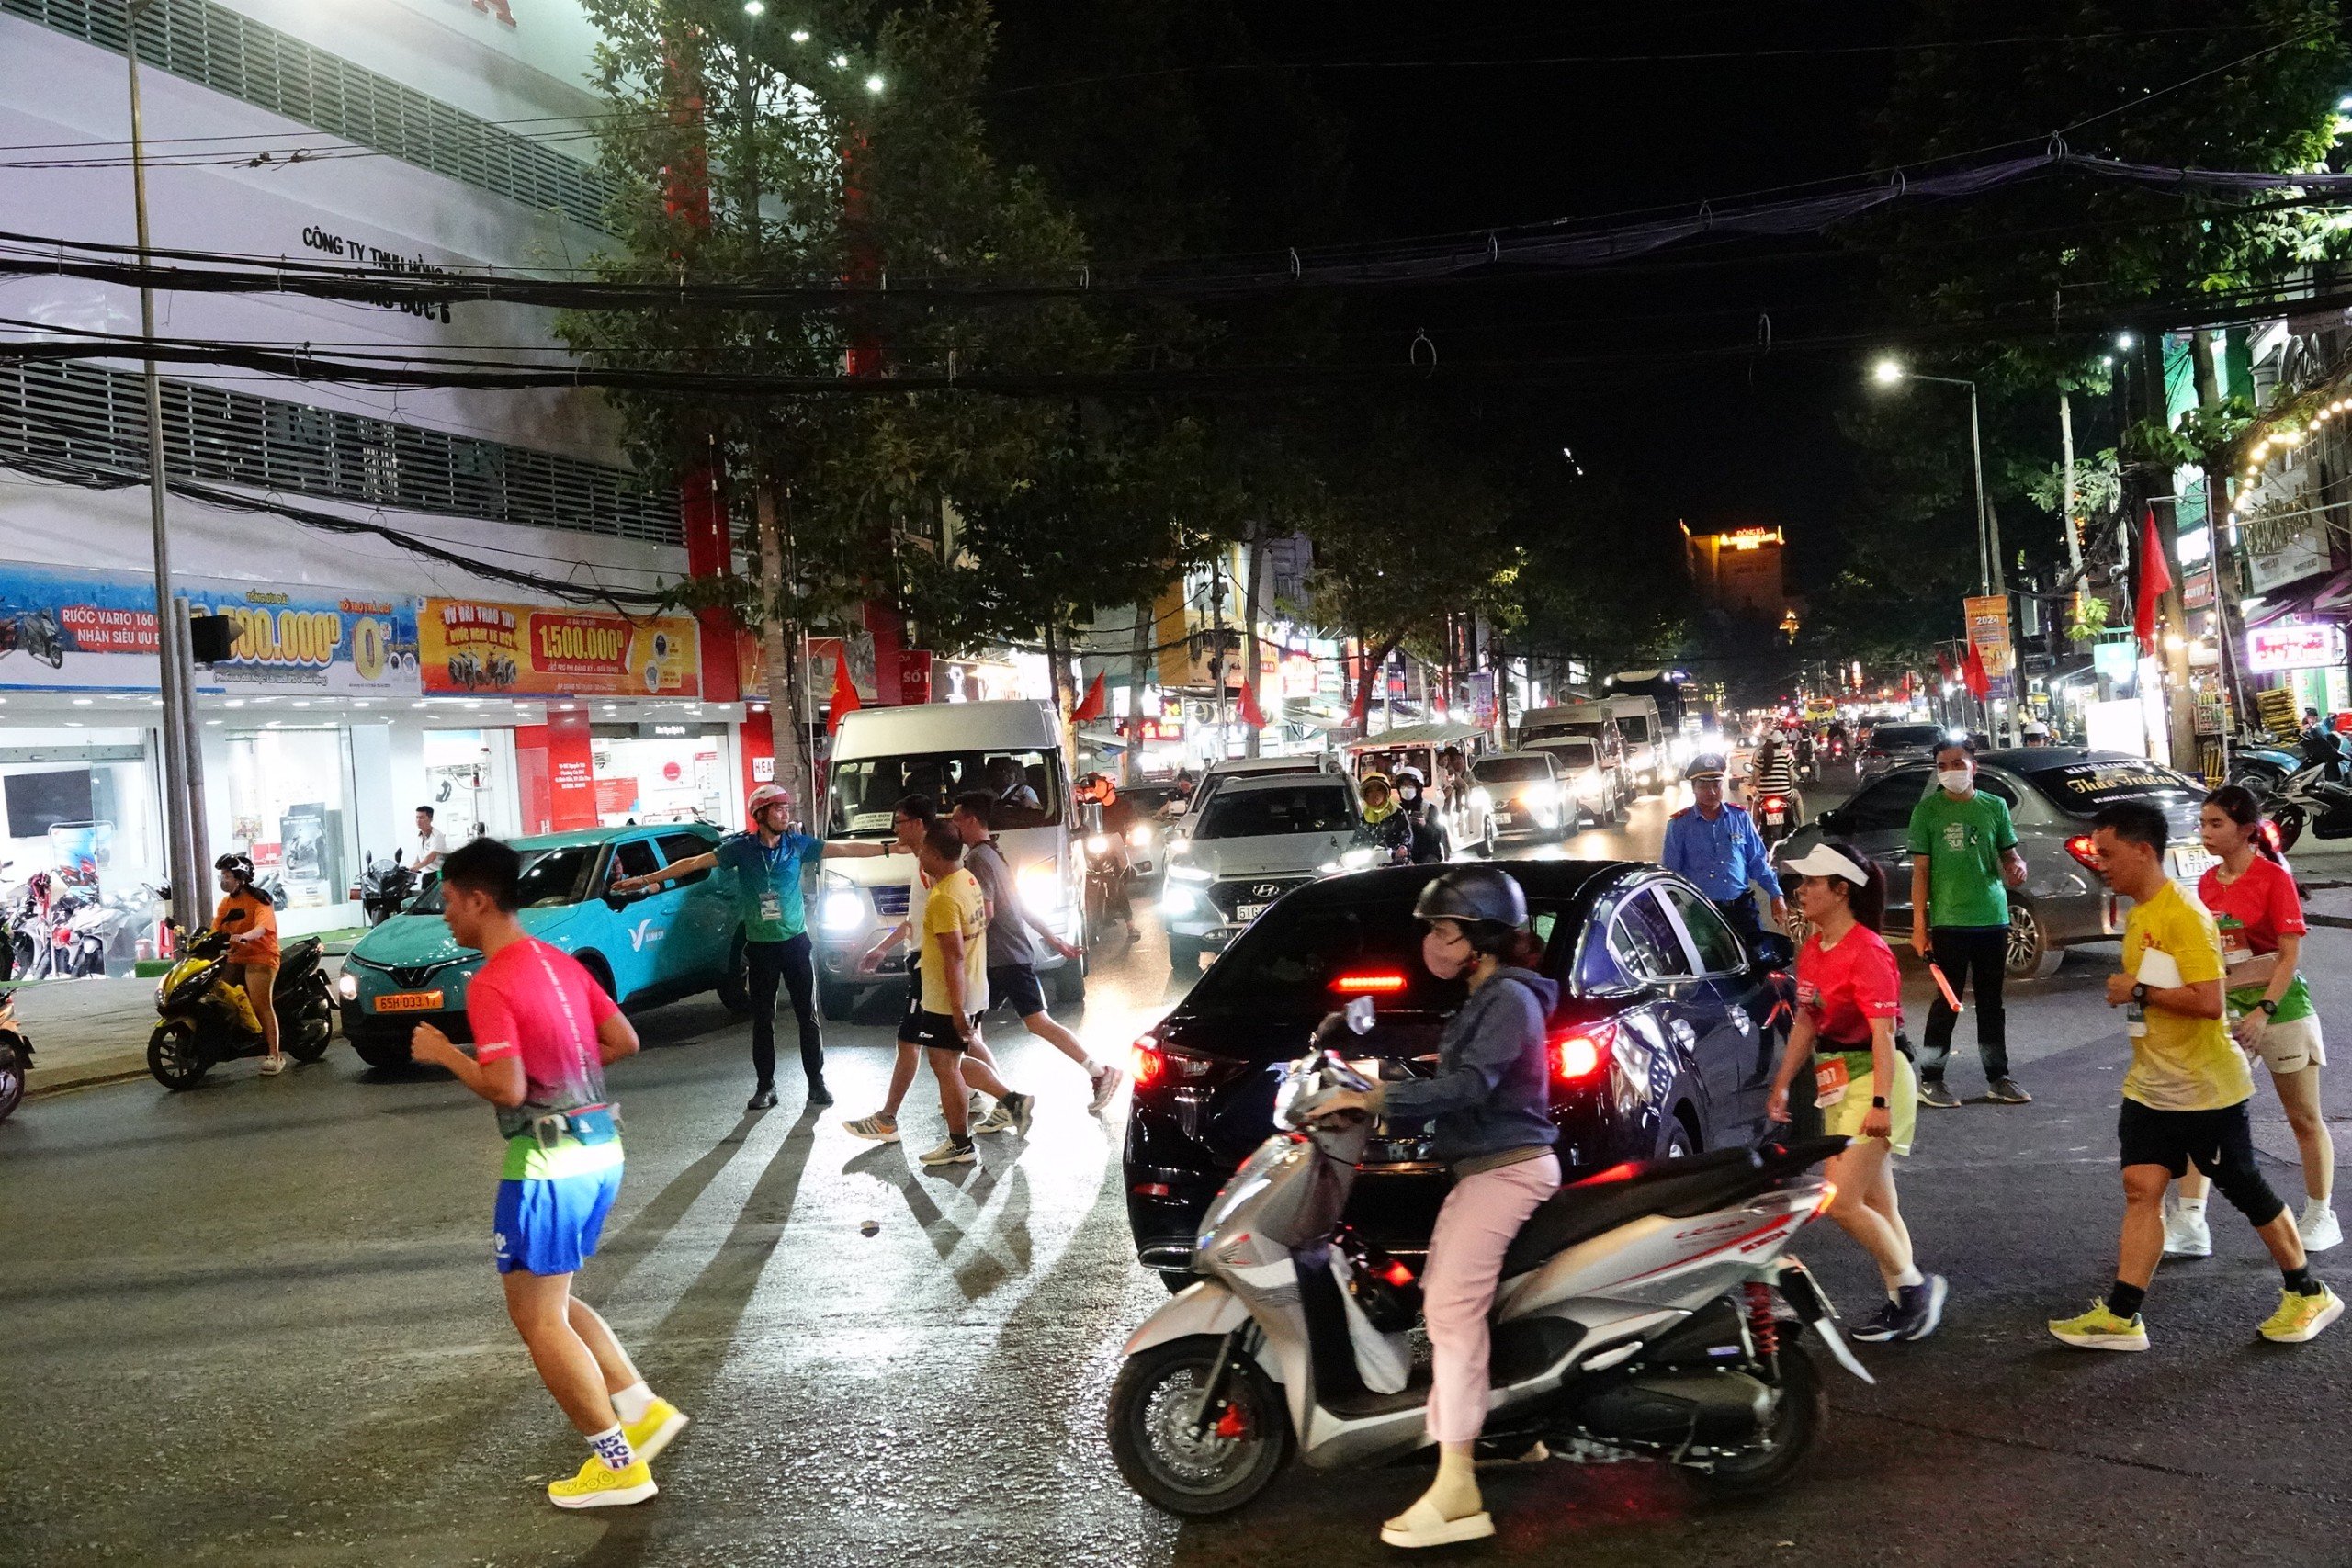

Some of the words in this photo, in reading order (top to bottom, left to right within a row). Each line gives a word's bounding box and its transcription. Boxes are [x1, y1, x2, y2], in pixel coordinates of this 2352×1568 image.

[302, 226, 344, 255] CÔNG
[346, 240, 366, 261] TY
[62, 606, 96, 624] RƯỚC
[98, 610, 132, 626] VARIO
[135, 613, 154, 627] 160
[77, 626, 109, 647] NHẬN
[112, 626, 135, 644] SIÊU
[138, 631, 152, 645] ƯU
[903, 668, 922, 683] SỐ
[923, 671, 930, 683] 1
[753, 761, 775, 773] HEA
[2188, 850, 2207, 861] 67A
